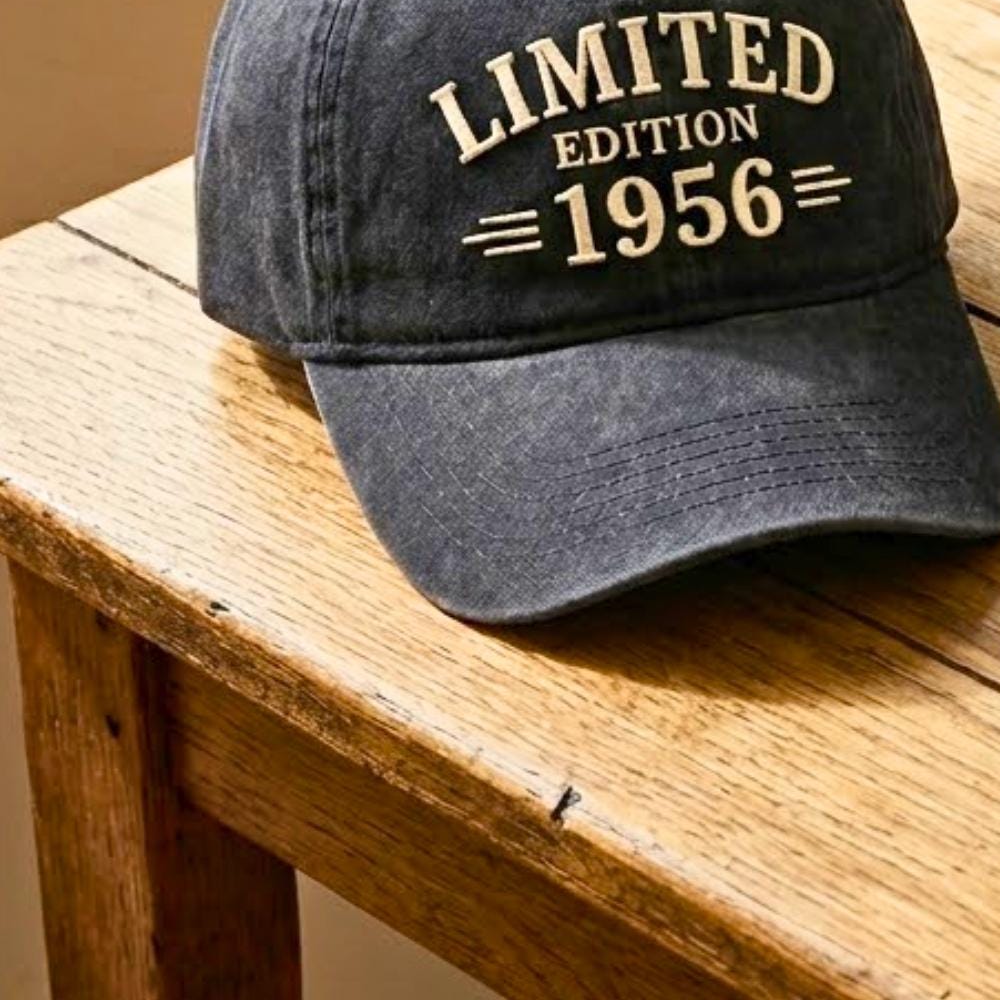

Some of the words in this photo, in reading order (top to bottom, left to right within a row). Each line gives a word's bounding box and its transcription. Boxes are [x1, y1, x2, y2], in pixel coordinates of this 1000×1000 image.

[429, 11, 835, 164] LIMITED
[553, 104, 760, 170] EDITION
[554, 157, 784, 266] 1956
